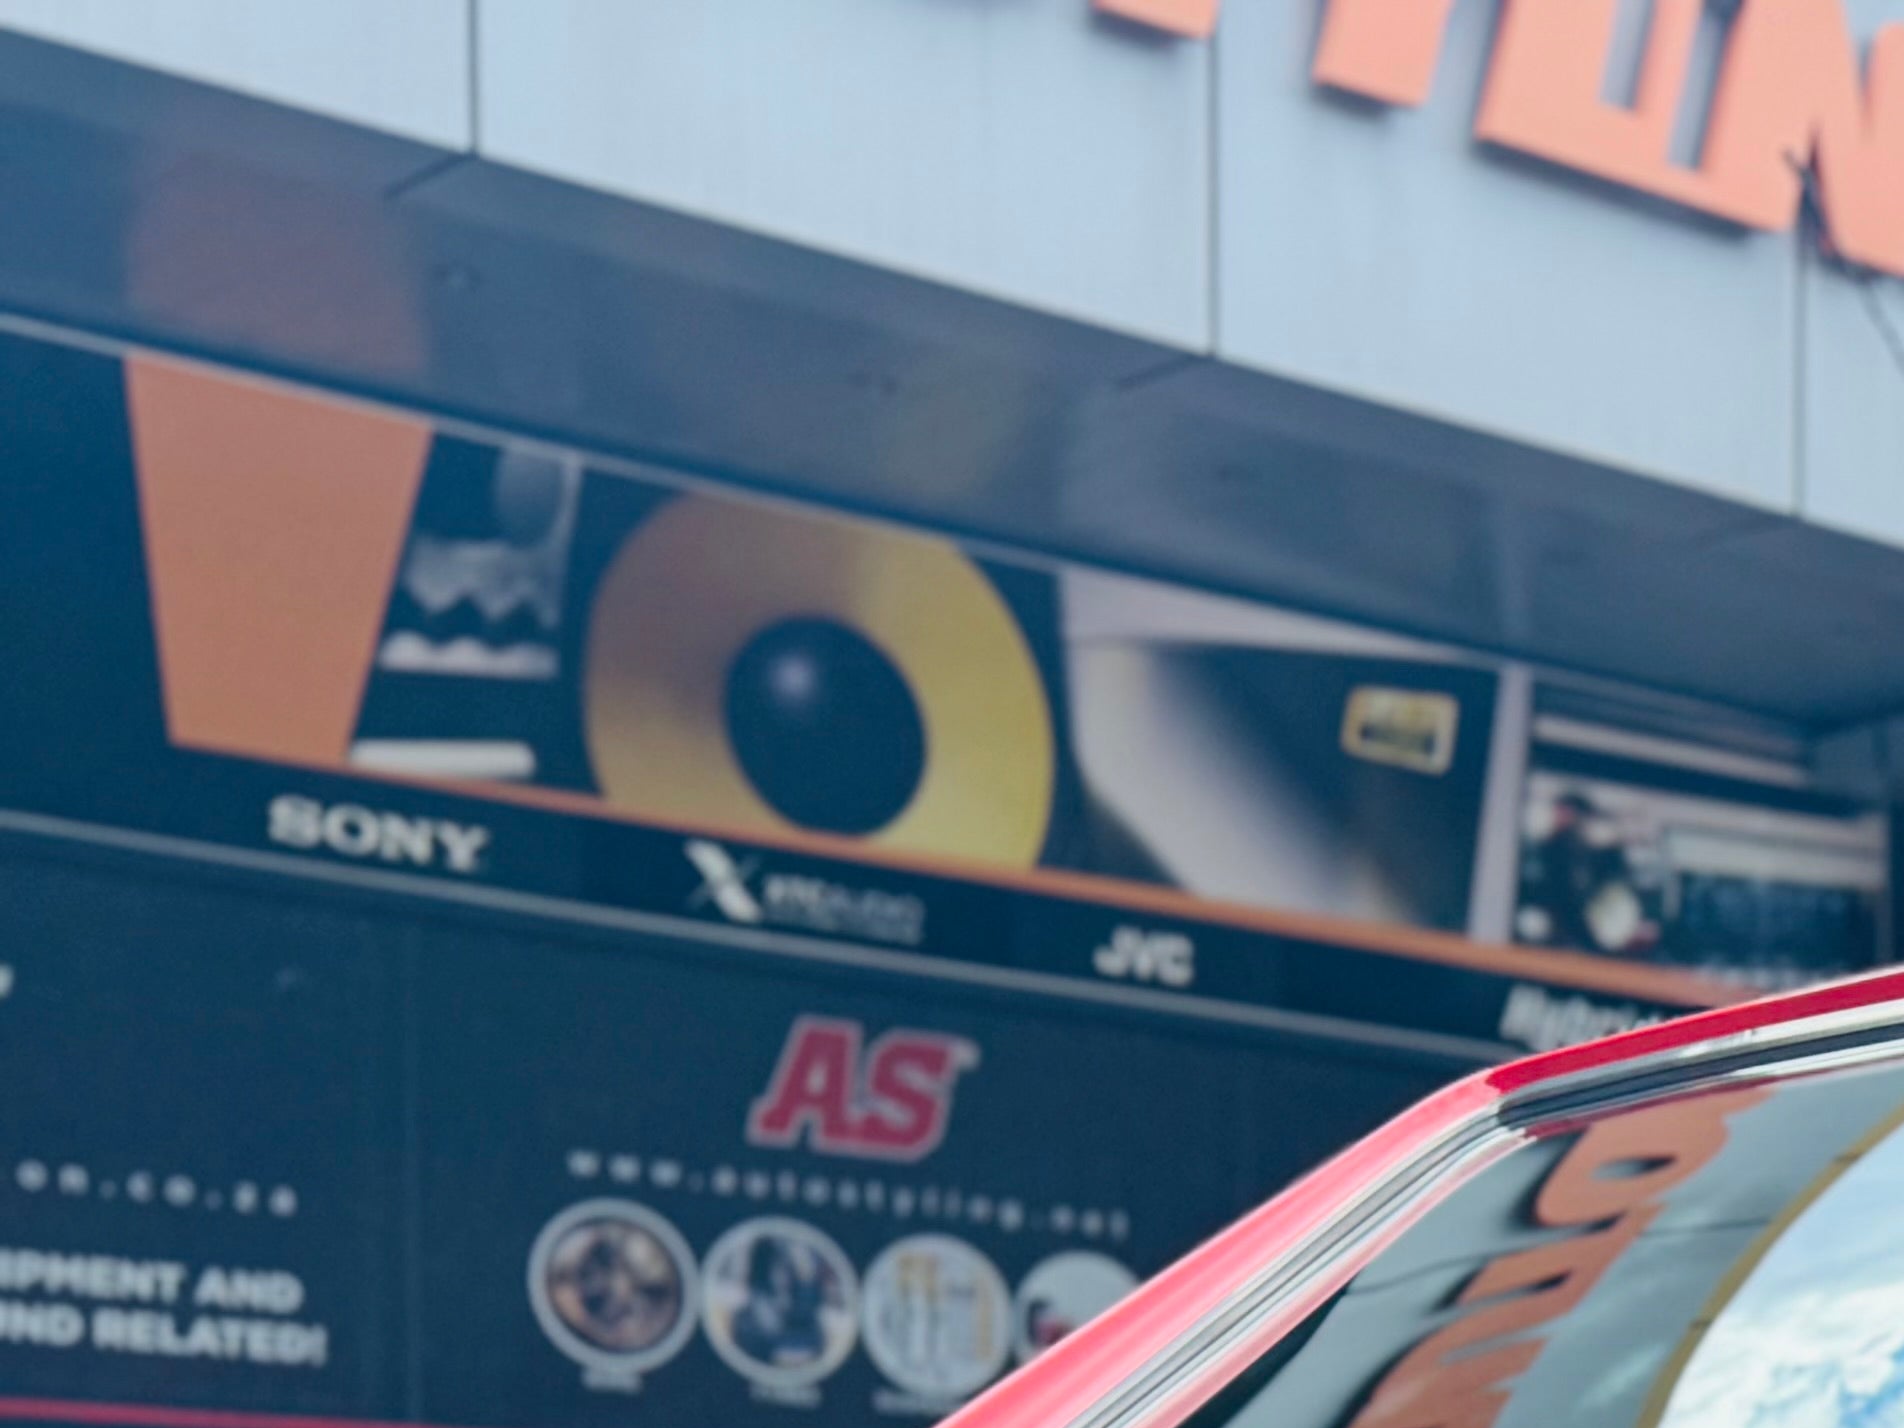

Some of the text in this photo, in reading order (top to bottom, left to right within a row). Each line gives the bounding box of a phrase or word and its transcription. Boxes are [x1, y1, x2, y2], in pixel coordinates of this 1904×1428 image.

[268, 794, 492, 874] SONY
[1092, 923, 1196, 987] JVC
[744, 1013, 972, 1163] AS
[194, 1265, 305, 1315] AND
